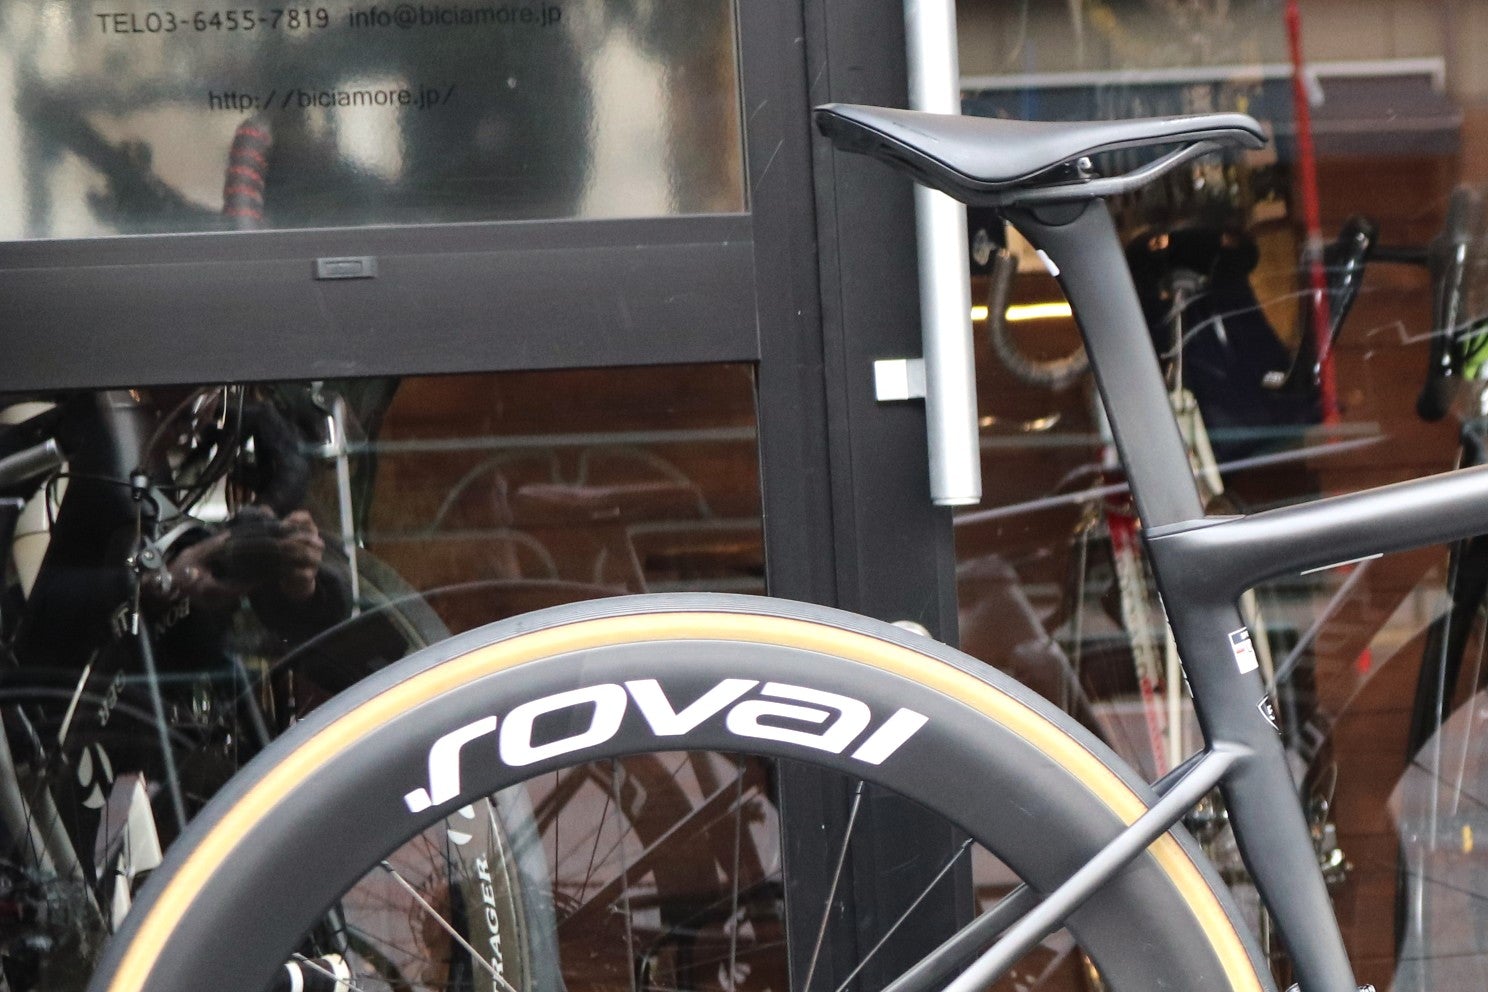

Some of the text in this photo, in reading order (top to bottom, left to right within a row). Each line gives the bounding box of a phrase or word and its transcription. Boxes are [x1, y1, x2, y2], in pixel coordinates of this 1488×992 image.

[97, 4, 563, 33] TEL03-6455-7819 info@biciamore.jp
[208, 83, 457, 114] http://biciamore.jp/
[403, 678, 930, 812] roval
